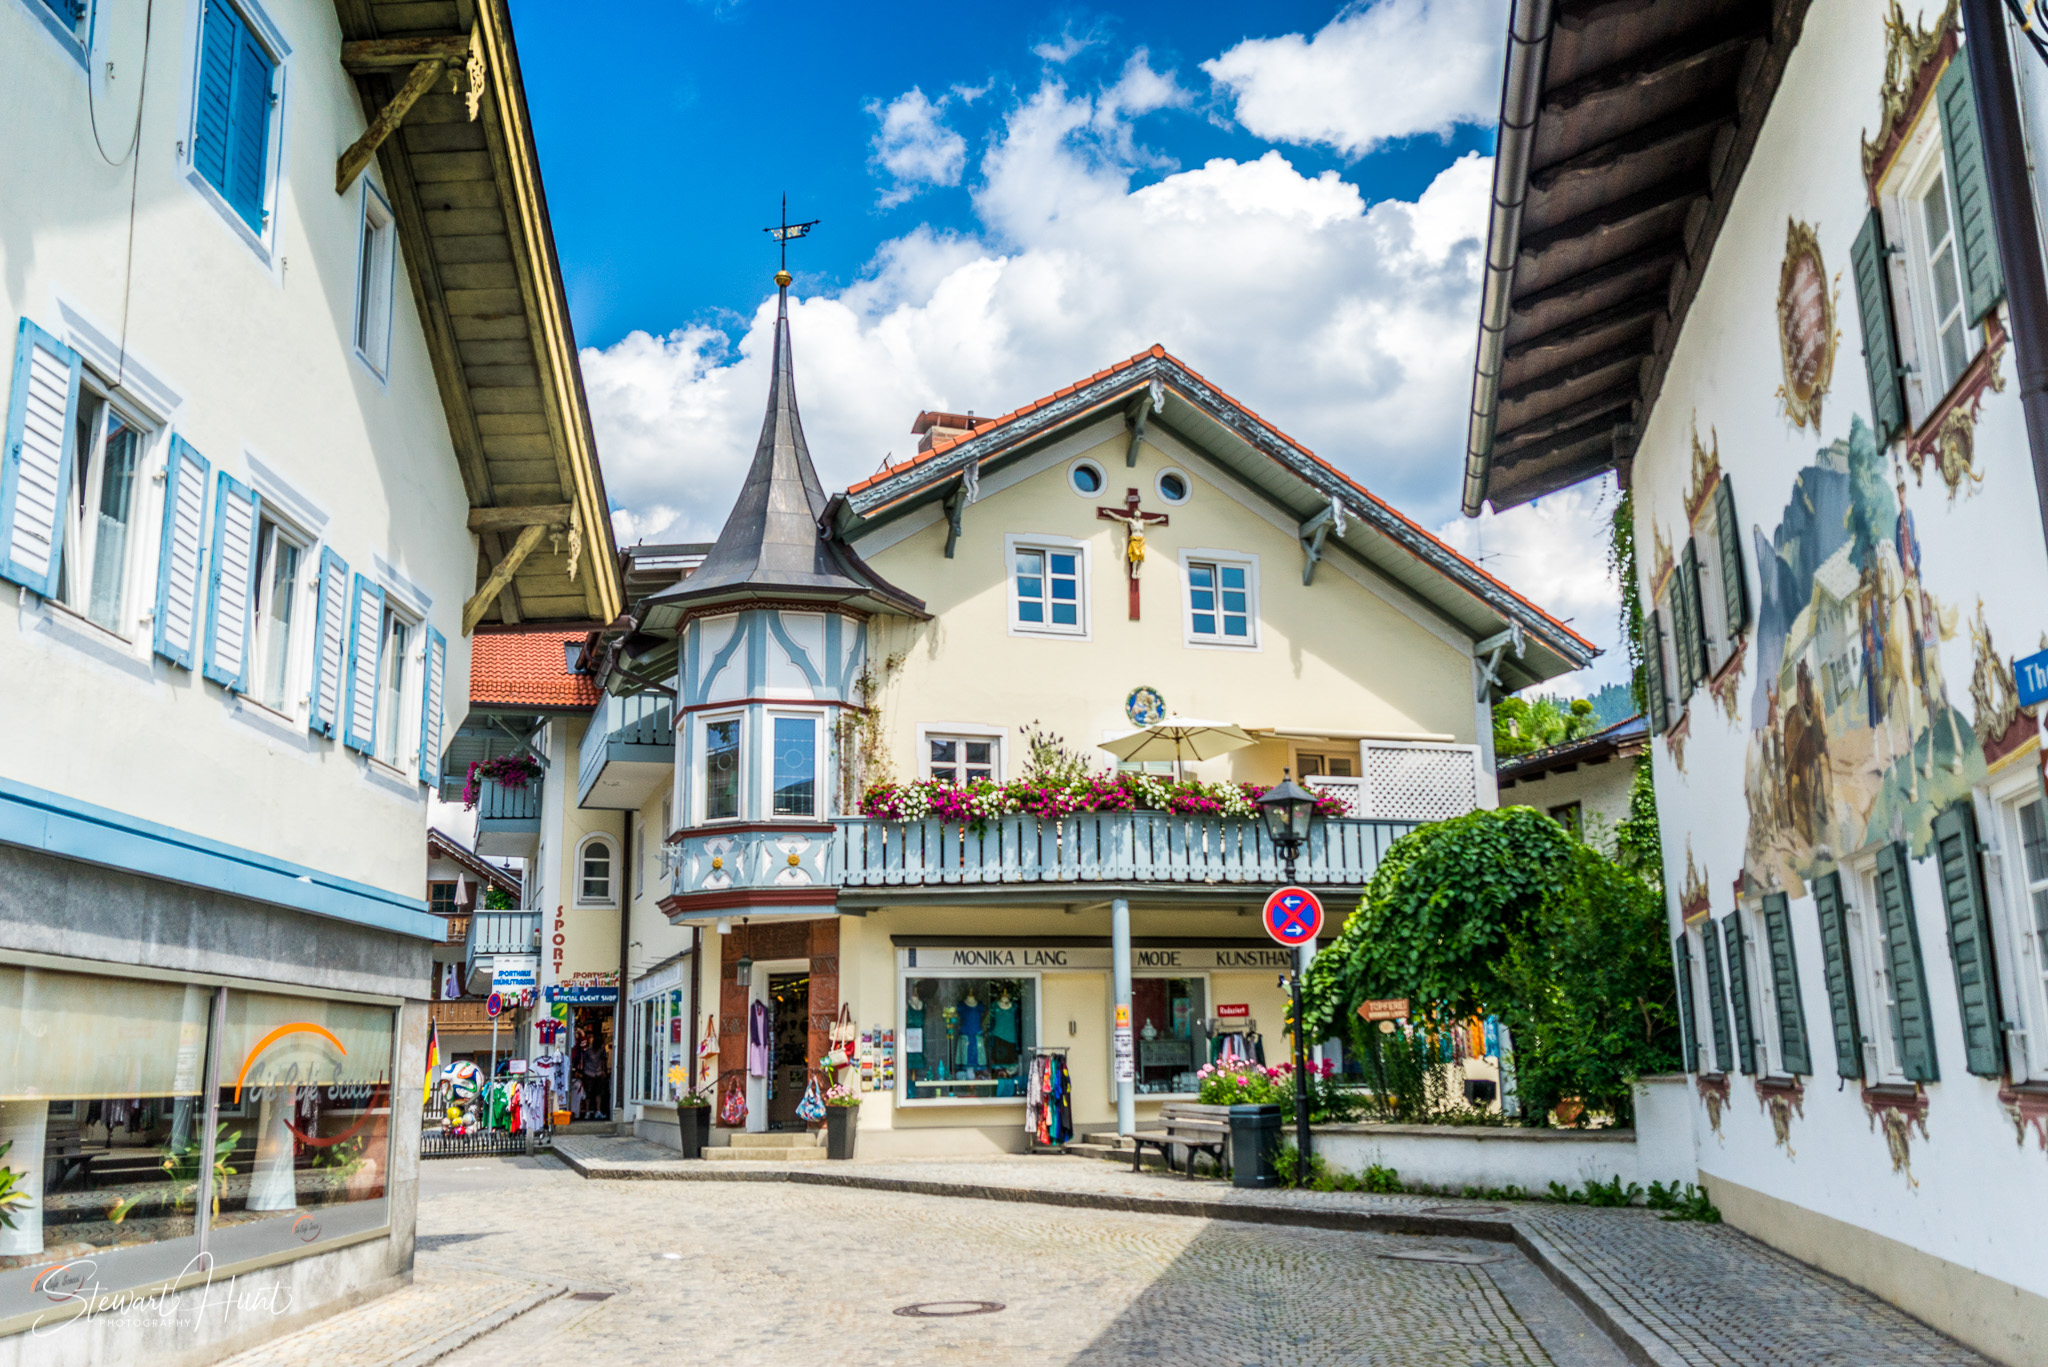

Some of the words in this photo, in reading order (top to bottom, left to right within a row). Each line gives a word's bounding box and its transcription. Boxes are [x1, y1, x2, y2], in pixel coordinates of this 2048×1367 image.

[2023, 662, 2048, 693] Th
[552, 904, 566, 974] SPORT
[953, 950, 1015, 966] MONIKA
[1023, 950, 1068, 966] LANG
[1137, 950, 1182, 966] MODE
[284, 1061, 319, 1116] Café
